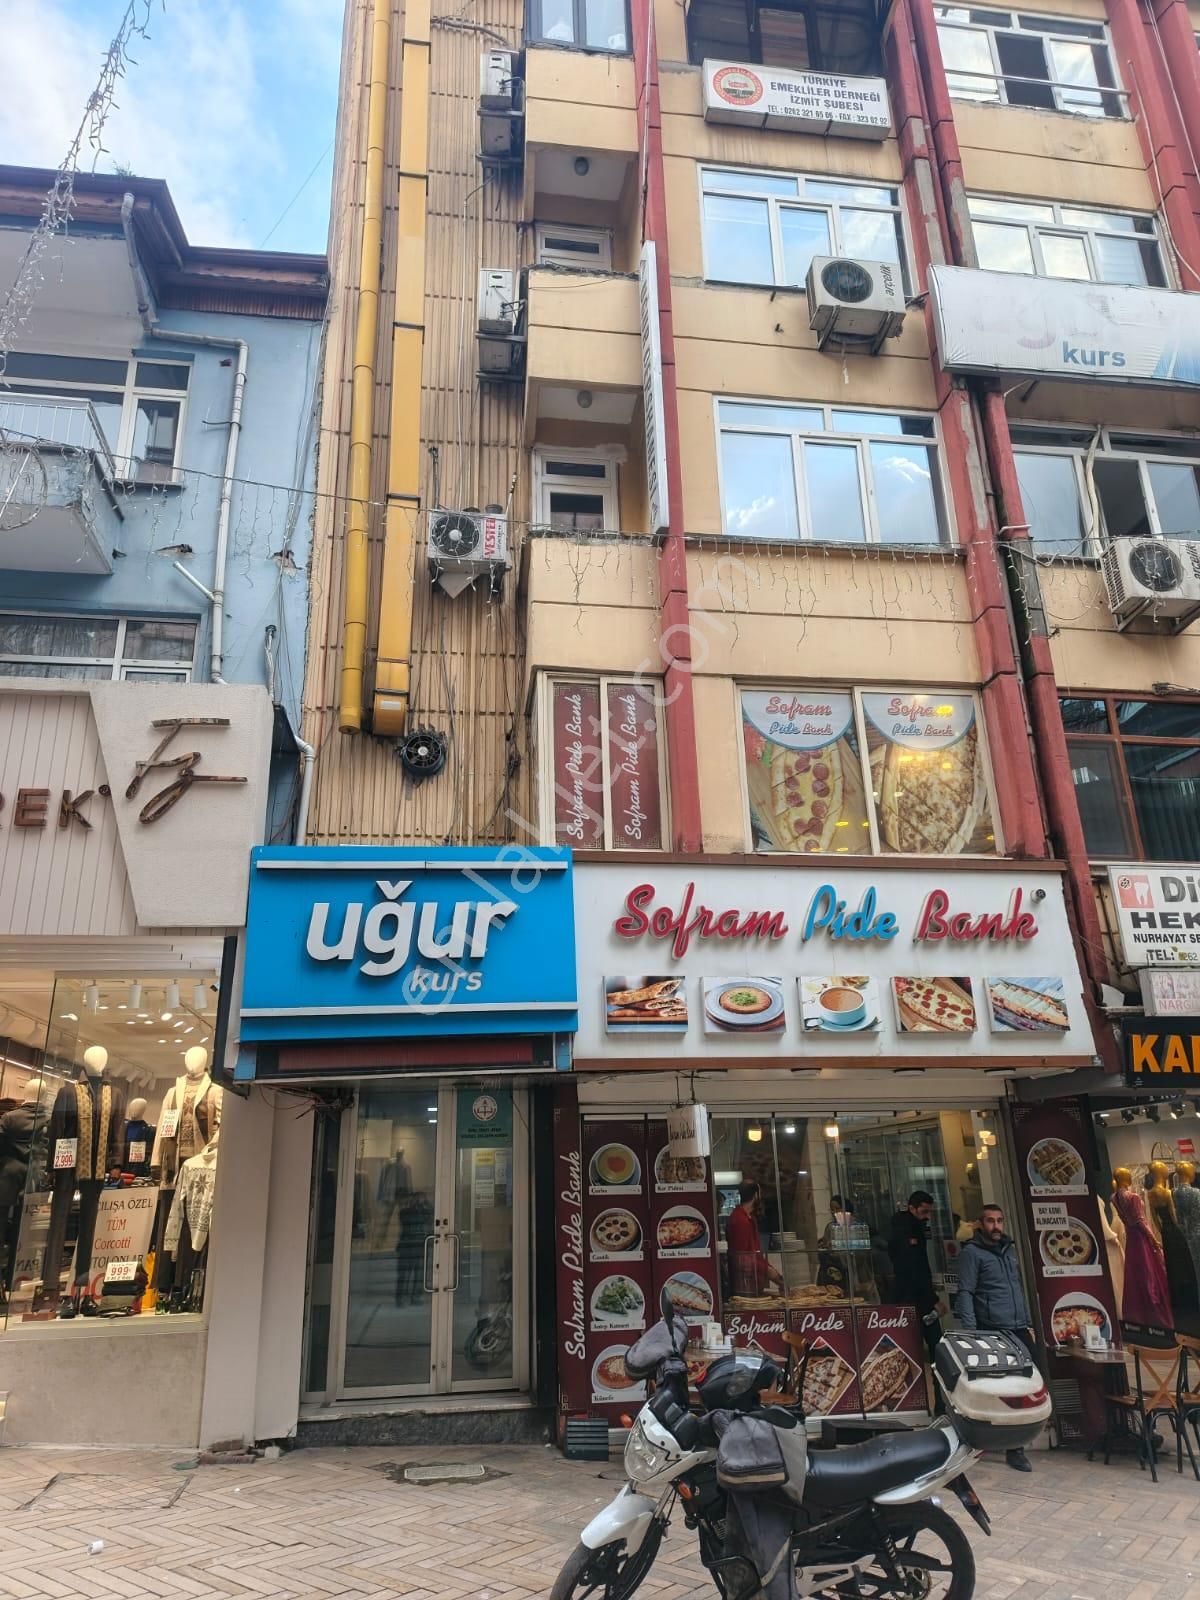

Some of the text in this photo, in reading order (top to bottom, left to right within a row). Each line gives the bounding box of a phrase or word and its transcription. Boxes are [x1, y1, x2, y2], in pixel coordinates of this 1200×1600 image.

[770, 82, 881, 103] EMEKLİLER DERNEĞİ
[802, 75, 847, 88] TÜRKİYE
[790, 95, 864, 112] İZMİT ŞUBESİ
[1063, 341, 1126, 367] kurs
[765, 696, 832, 719] Sofram
[887, 698, 954, 722] Sofram
[769, 720, 833, 736] Pide Bank
[891, 722, 954, 737] Pide Bank
[565, 693, 590, 839] Sofram Pide Bank
[618, 694, 647, 840] Sofram Pide Bank
[0, 788, 95, 829] EK
[306, 880, 518, 977] uğur
[614, 881, 1038, 960] Sofram Pide Bank
[1133, 933, 1187, 944] NURHAYAT
[410, 965, 482, 992] kurs
[560, 1151, 581, 1206] Bank
[127, 1197, 153, 1210] ÖZEL
[106, 1216, 127, 1231] TÜM
[94, 1236, 132, 1250] Corcotti
[561, 1212, 583, 1273] Pide
[110, 1266, 129, 1276] 999
[727, 1309, 909, 1340] Sofram Pide Bank
